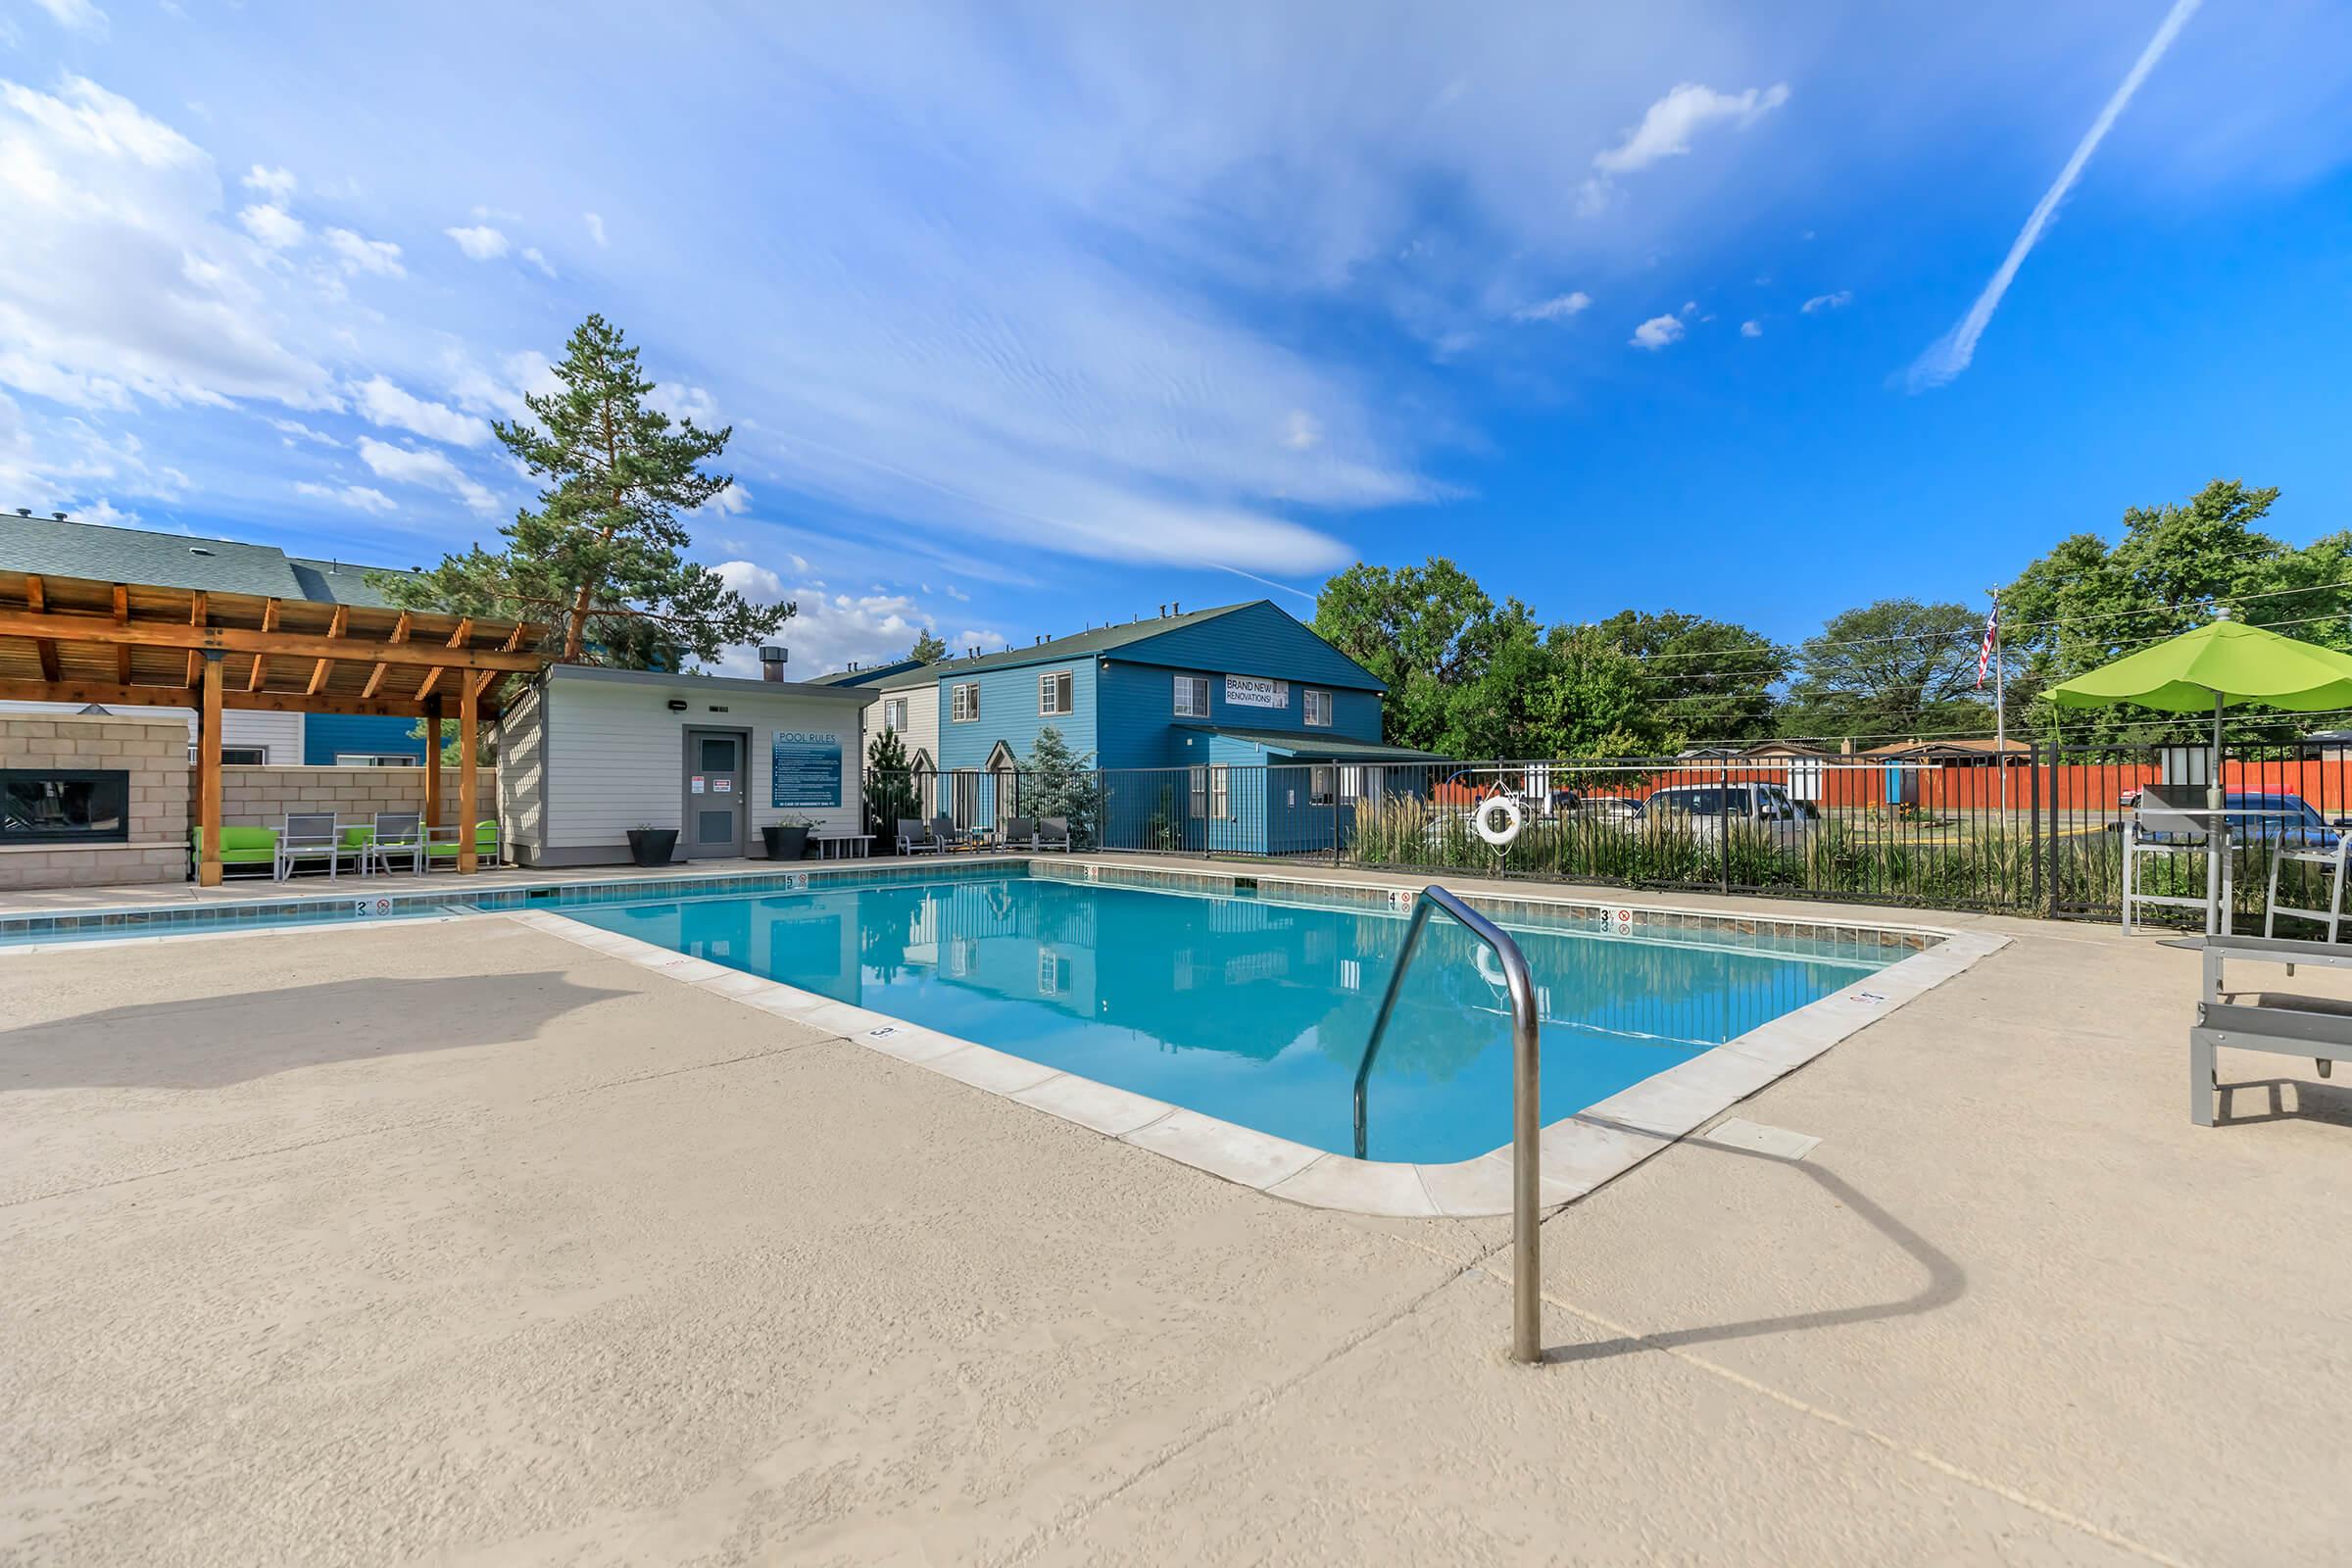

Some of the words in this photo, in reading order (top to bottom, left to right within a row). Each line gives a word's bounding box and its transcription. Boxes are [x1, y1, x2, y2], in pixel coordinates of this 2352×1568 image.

[1227, 678, 1253, 691] BRAND
[1254, 681, 1272, 693] NEW
[1227, 691, 1271, 703] RENOVATIONS!
[780, 732, 808, 742] POOL
[808, 733, 836, 743] RULES
[787, 875, 793, 886] 5
[1389, 892, 1396, 903] 4
[1601, 909, 1609, 921] 3
